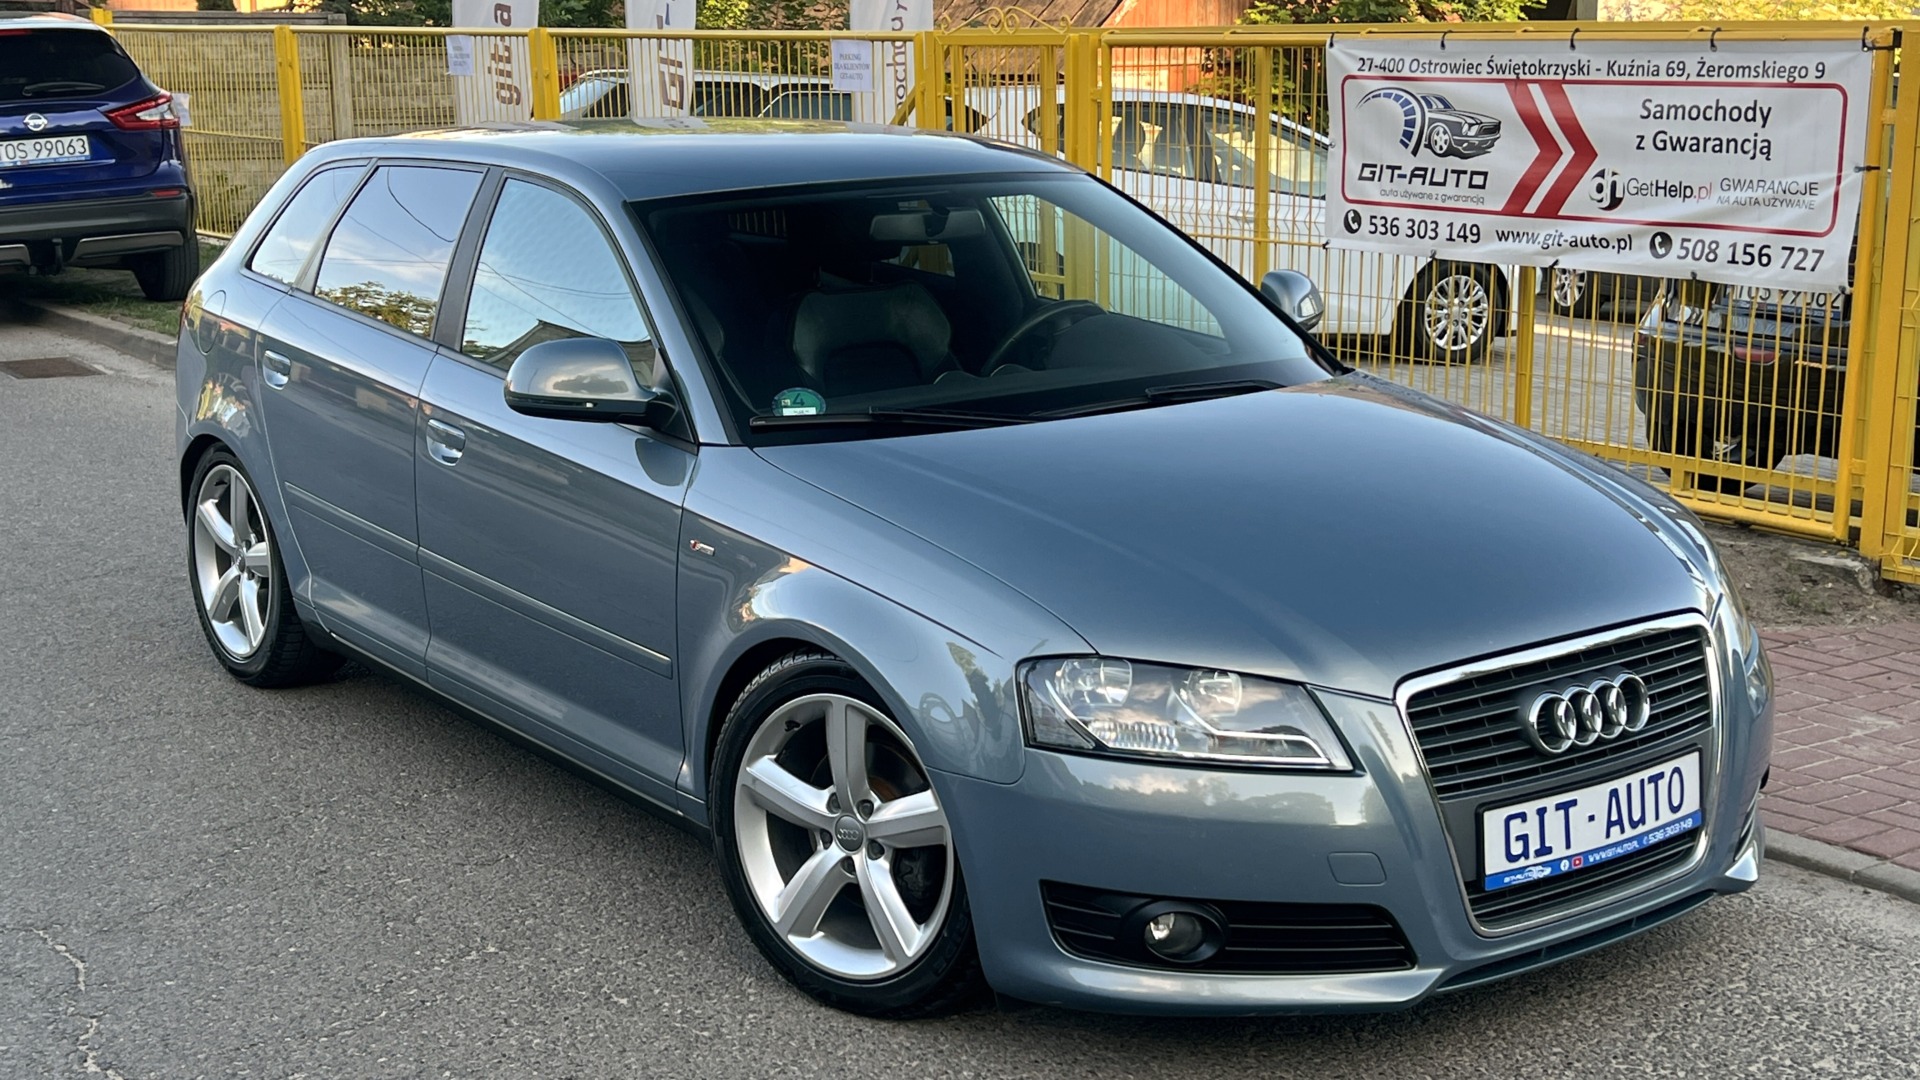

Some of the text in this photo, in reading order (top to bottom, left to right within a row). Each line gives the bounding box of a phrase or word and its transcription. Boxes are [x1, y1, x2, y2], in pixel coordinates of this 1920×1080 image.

[1357, 57, 1405, 73] 27-400
[1408, 57, 1482, 75] Ostrowiec
[1486, 55, 1591, 79] Świętokrzyski
[1606, 59, 1660, 77] Kuźnia
[1665, 60, 1691, 80] 69,
[1696, 57, 1809, 83] Żeromskiego
[1815, 61, 1826, 79] 9
[1639, 98, 1772, 128] Samochody
[33, 138, 87, 158] 99063
[1635, 130, 1772, 161] z Gwarancją
[1357, 163, 1489, 190] GIT-AUTO
[1719, 177, 1819, 197] GWARANCJE
[1379, 188, 1399, 198] auta
[1400, 189, 1433, 200] używane
[1440, 194, 1485, 205] gwarancją
[1626, 177, 1712, 203] GetHelp.pl
[1716, 195, 1815, 210] NA AUTA UŻYWANE
[1368, 215, 1481, 244] 536 303 149
[1495, 229, 1632, 254] www.git-auto.pl
[1676, 237, 1825, 272] 508 156 727
[791, 392, 806, 406] 4
